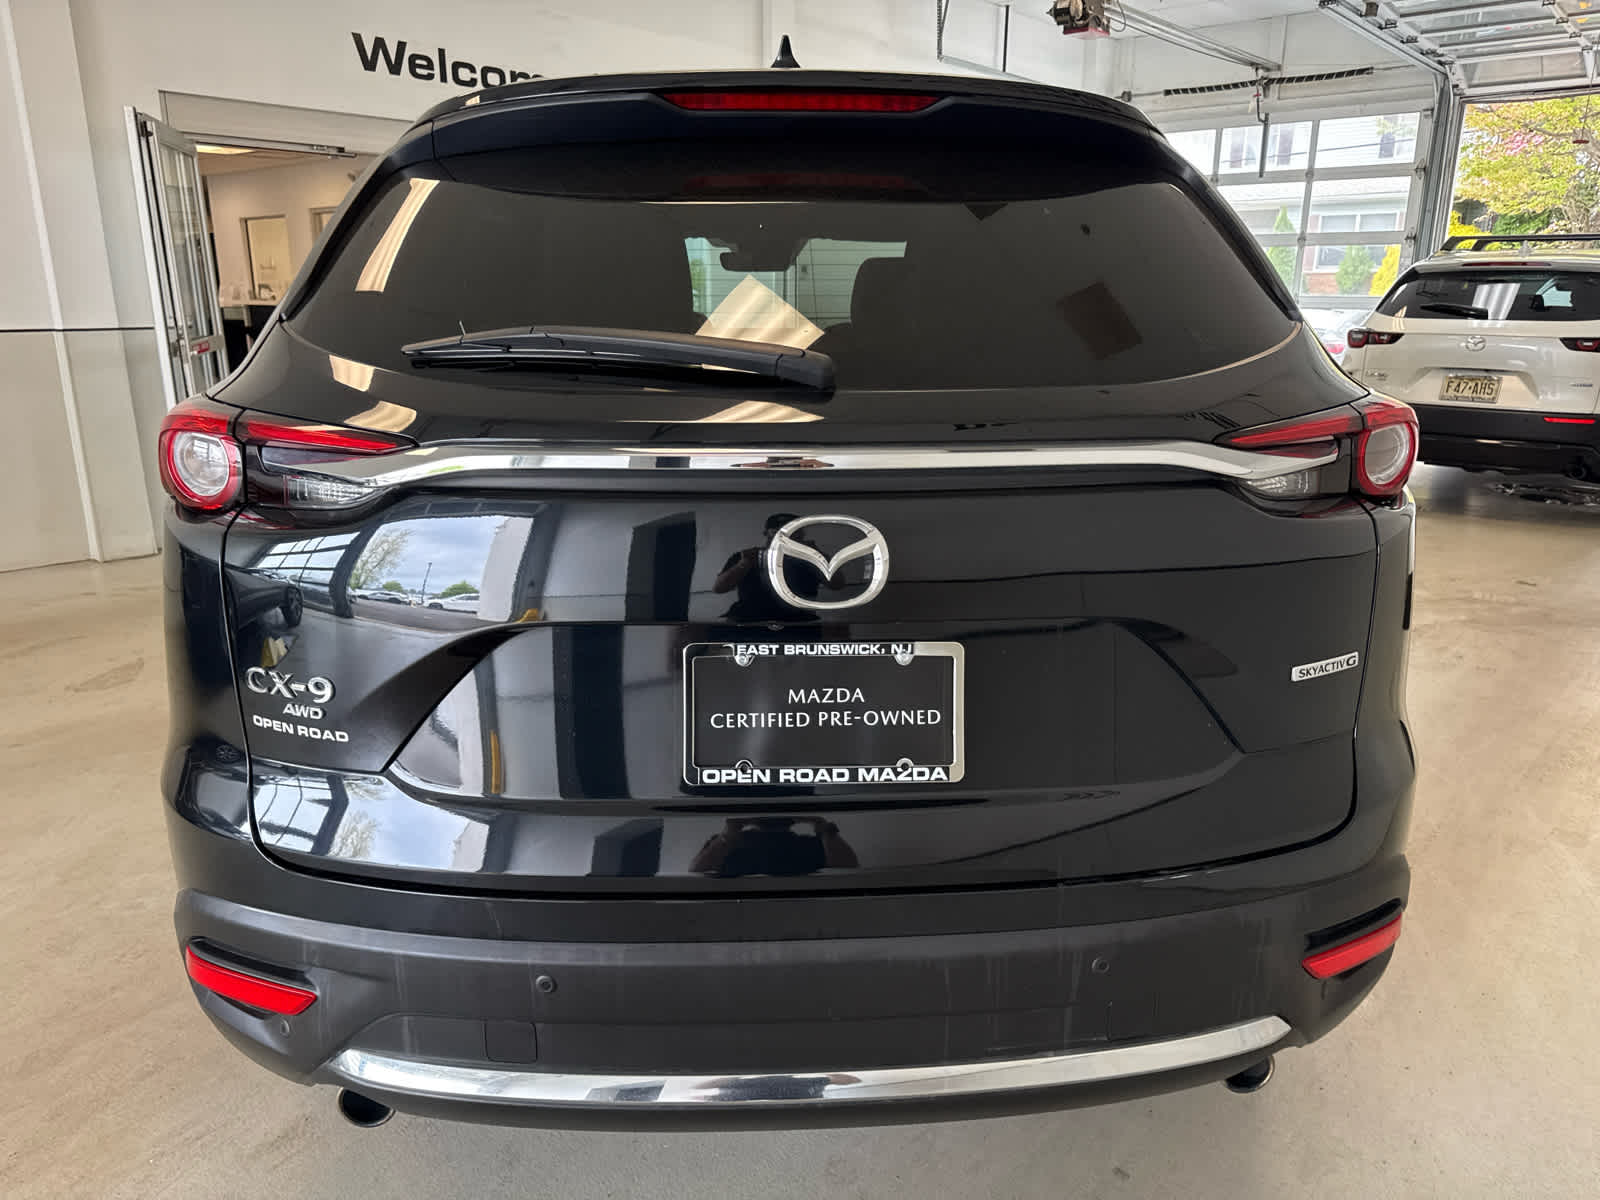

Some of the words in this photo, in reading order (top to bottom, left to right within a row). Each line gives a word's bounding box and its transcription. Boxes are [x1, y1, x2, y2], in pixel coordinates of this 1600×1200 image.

[737, 644, 779, 656] EAST
[784, 644, 886, 656] BRUNSWICK,
[891, 644, 912, 656] NJ
[247, 667, 334, 704] CX-9
[788, 688, 865, 704] MAZDA
[282, 703, 324, 720] AWD
[710, 712, 810, 729] CERTIFIED
[818, 709, 941, 727] PRE-OWNED
[252, 714, 294, 735] OPEN
[297, 725, 350, 743] ROAD
[702, 769, 771, 784] OPEN
[779, 768, 850, 783] ROAD
[858, 767, 949, 782] MAZDA
